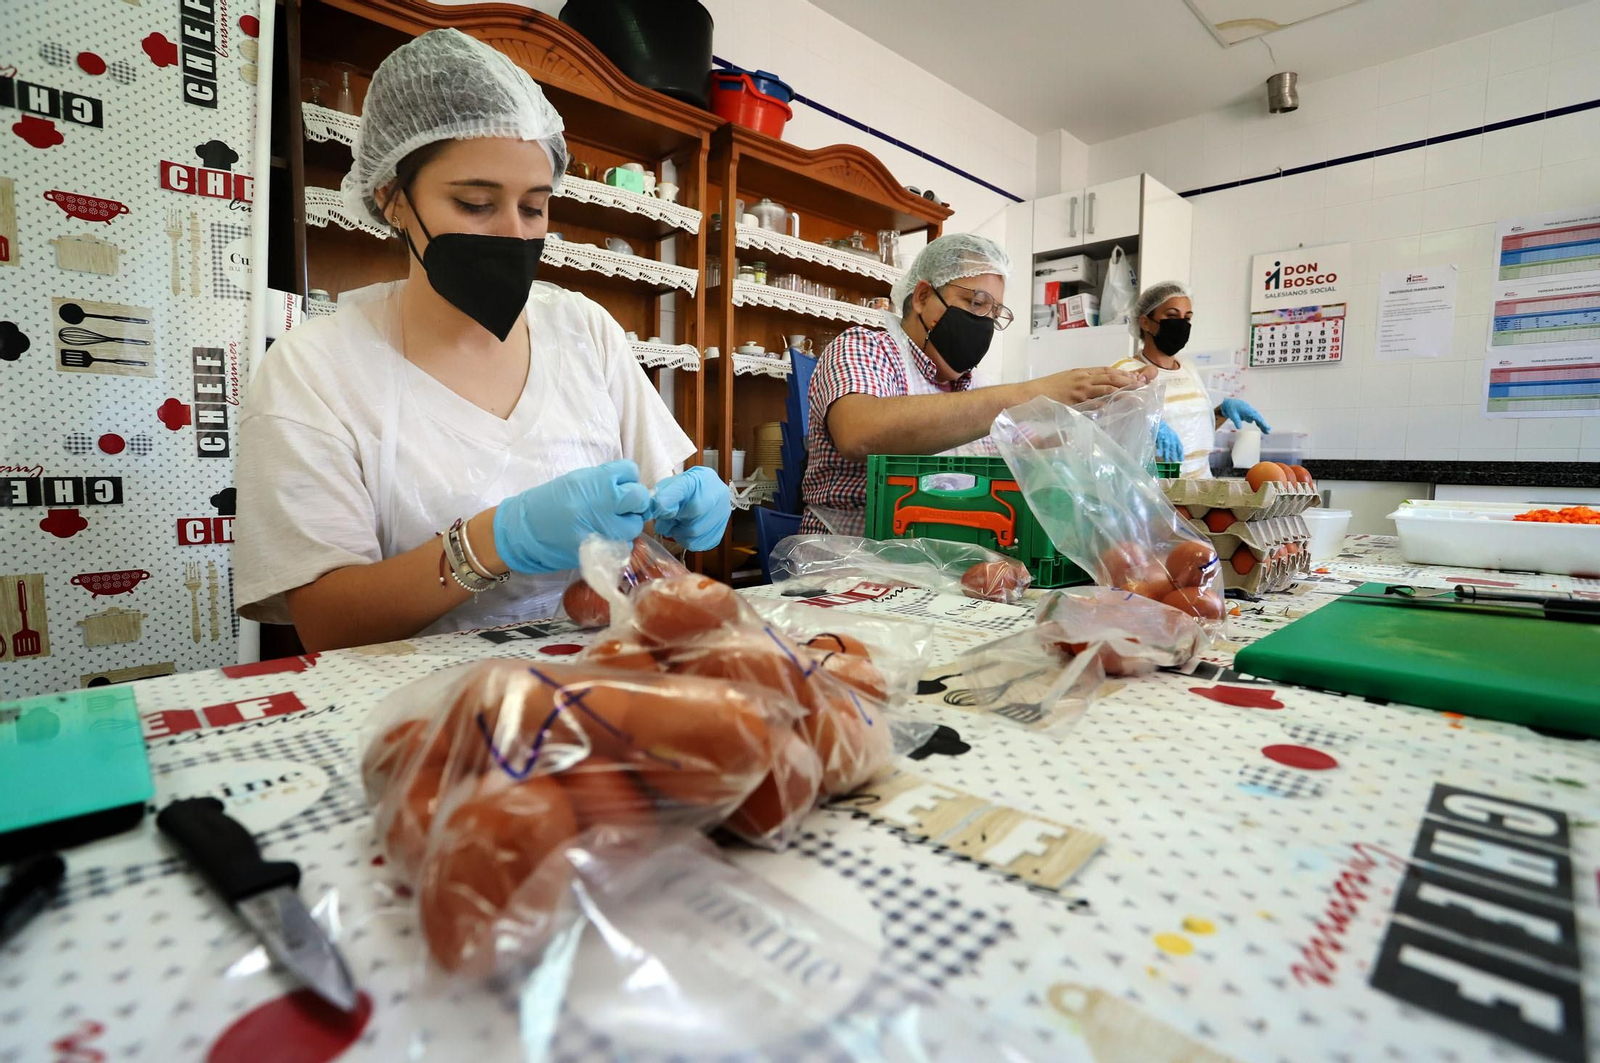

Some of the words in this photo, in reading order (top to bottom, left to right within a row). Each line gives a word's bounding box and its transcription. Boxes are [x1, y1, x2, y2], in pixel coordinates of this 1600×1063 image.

[168, 164, 254, 200] CHE
[1283, 273, 1338, 289] BOSCO
[1284, 262, 1318, 276] DON
[1264, 290, 1308, 299] SALESIANOS
[1310, 286, 1336, 295] SOCIAL
[197, 355, 227, 452] CHEF
[11, 479, 114, 504] CHE
[1398, 794, 1566, 1035] CHEF
